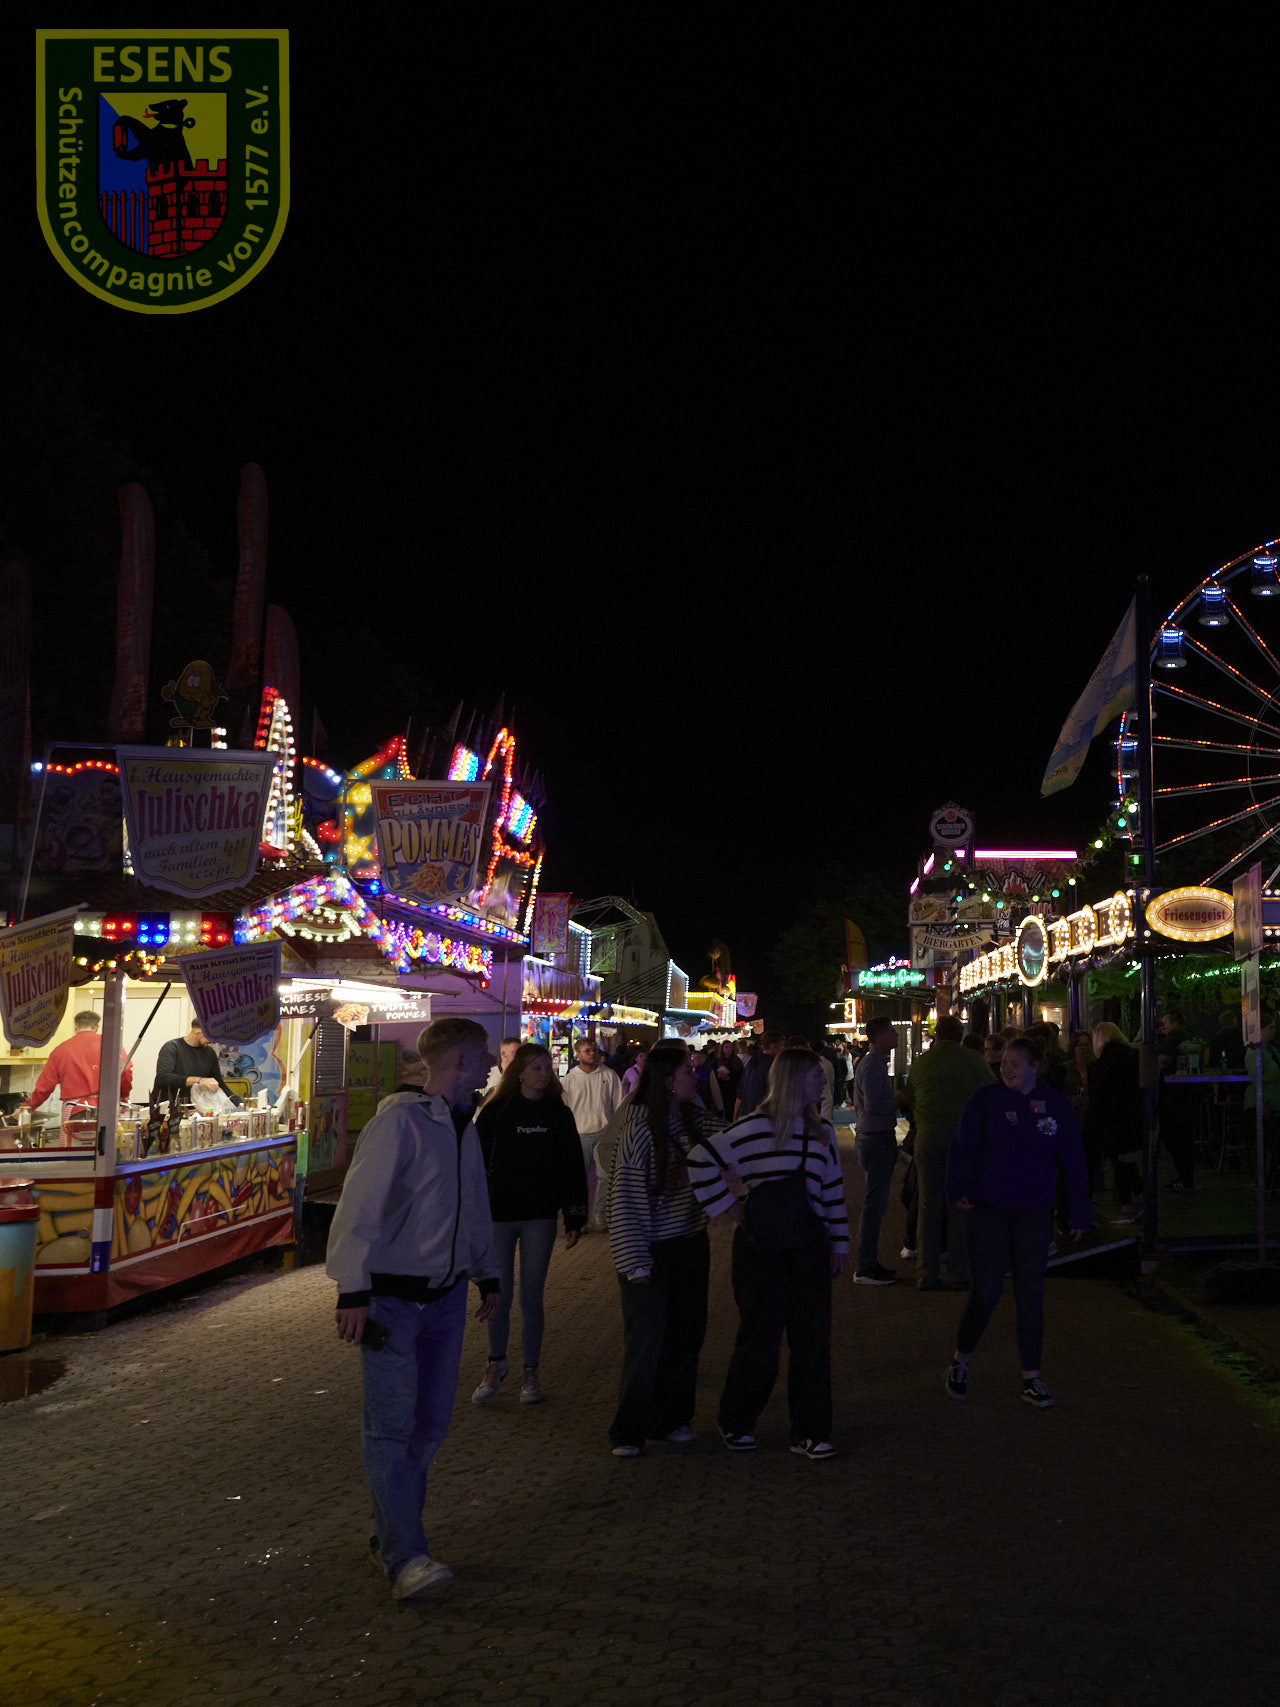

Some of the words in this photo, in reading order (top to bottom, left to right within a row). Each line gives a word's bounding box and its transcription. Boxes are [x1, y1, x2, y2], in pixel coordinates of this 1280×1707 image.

[143, 766, 259, 785] Hausgemachter
[387, 790, 460, 807] ECHT
[136, 785, 260, 845] Julischka
[380, 802, 482, 818] HOLLÄNDISCHE
[144, 843, 176, 859] nach
[180, 838, 218, 854] altem
[380, 817, 482, 870] POMMES
[1164, 908, 1226, 923] Friesengeist
[17, 927, 57, 945] Kroatien
[923, 935, 983, 949] BIERGARTEN
[211, 955, 255, 968] Kroatien
[6, 950, 70, 1018] Julischka
[858, 970, 897, 988] Blooming
[198, 973, 273, 1023] Julischka
[280, 1004, 316, 1015] MMES
[371, 1001, 419, 1013] TWISTER
[385, 1010, 427, 1021] POMMES
[516, 1126, 548, 1135] Pegador
